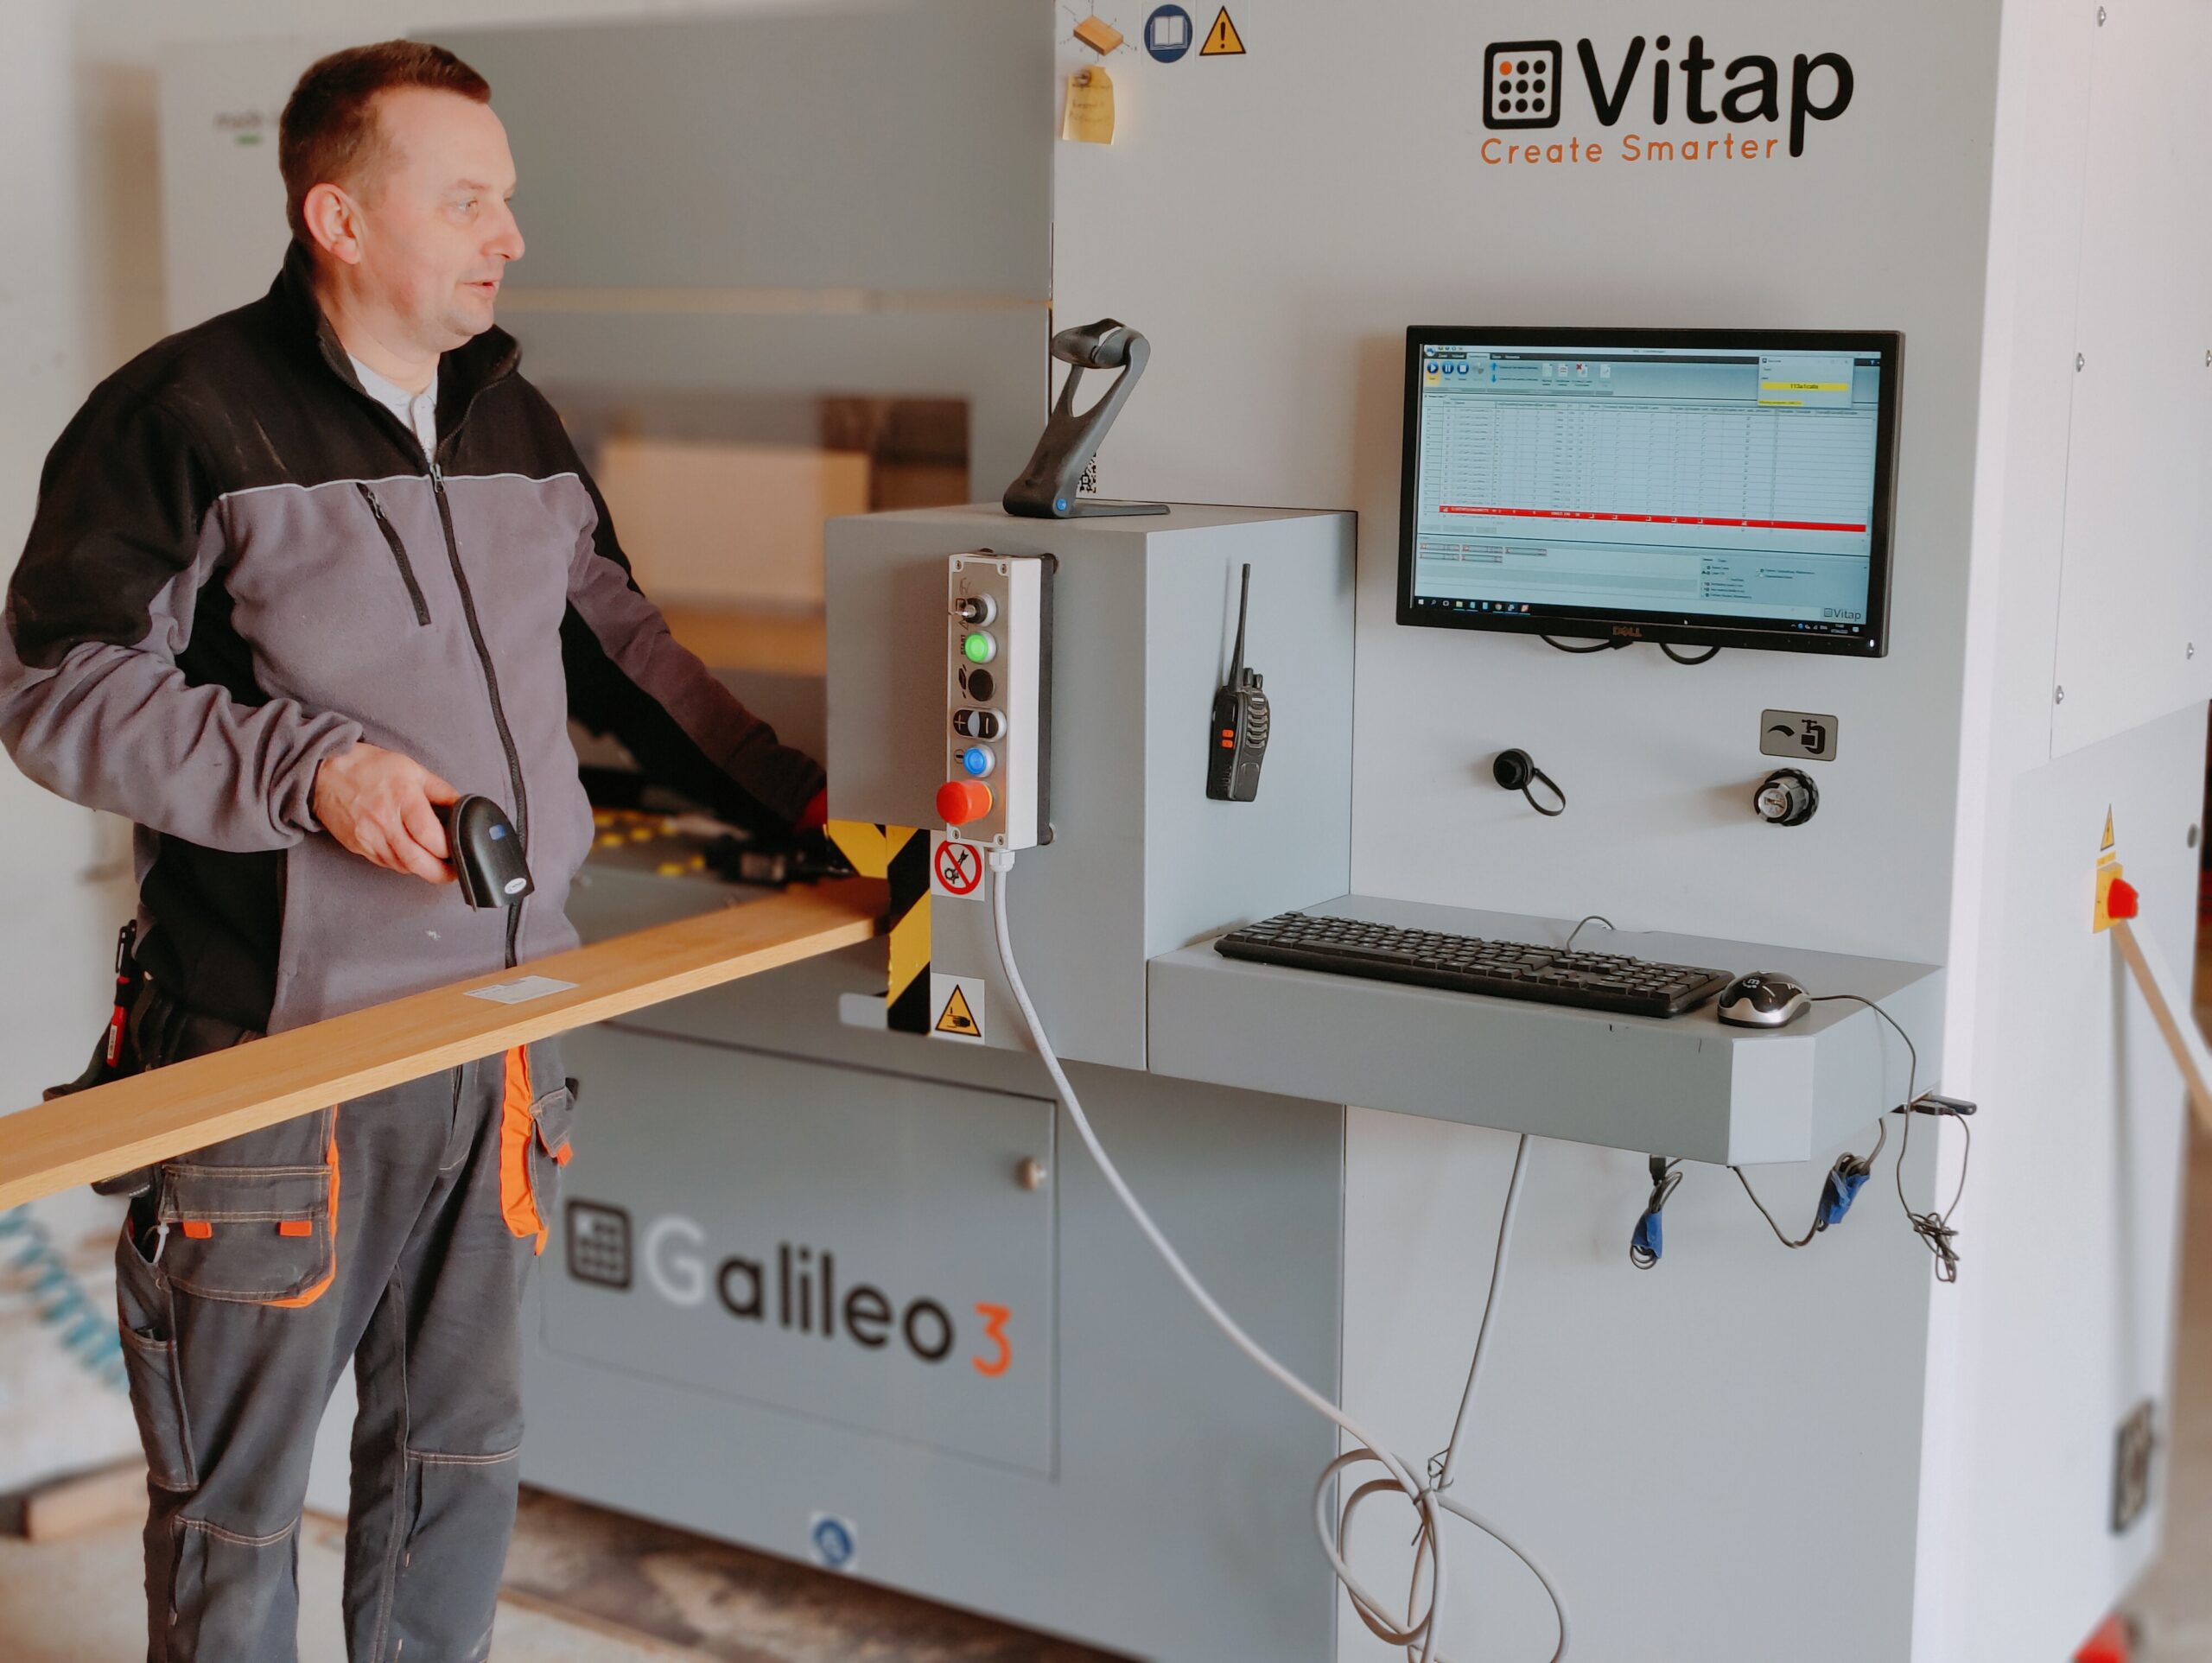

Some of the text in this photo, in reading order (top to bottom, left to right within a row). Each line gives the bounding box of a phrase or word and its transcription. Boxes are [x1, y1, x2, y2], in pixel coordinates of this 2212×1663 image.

[1577, 35, 1854, 157] Vitap
[1480, 133, 1778, 165] Create Smarter
[1834, 609, 1861, 622] Vitap
[644, 1215, 1013, 1377] Galileo 3
